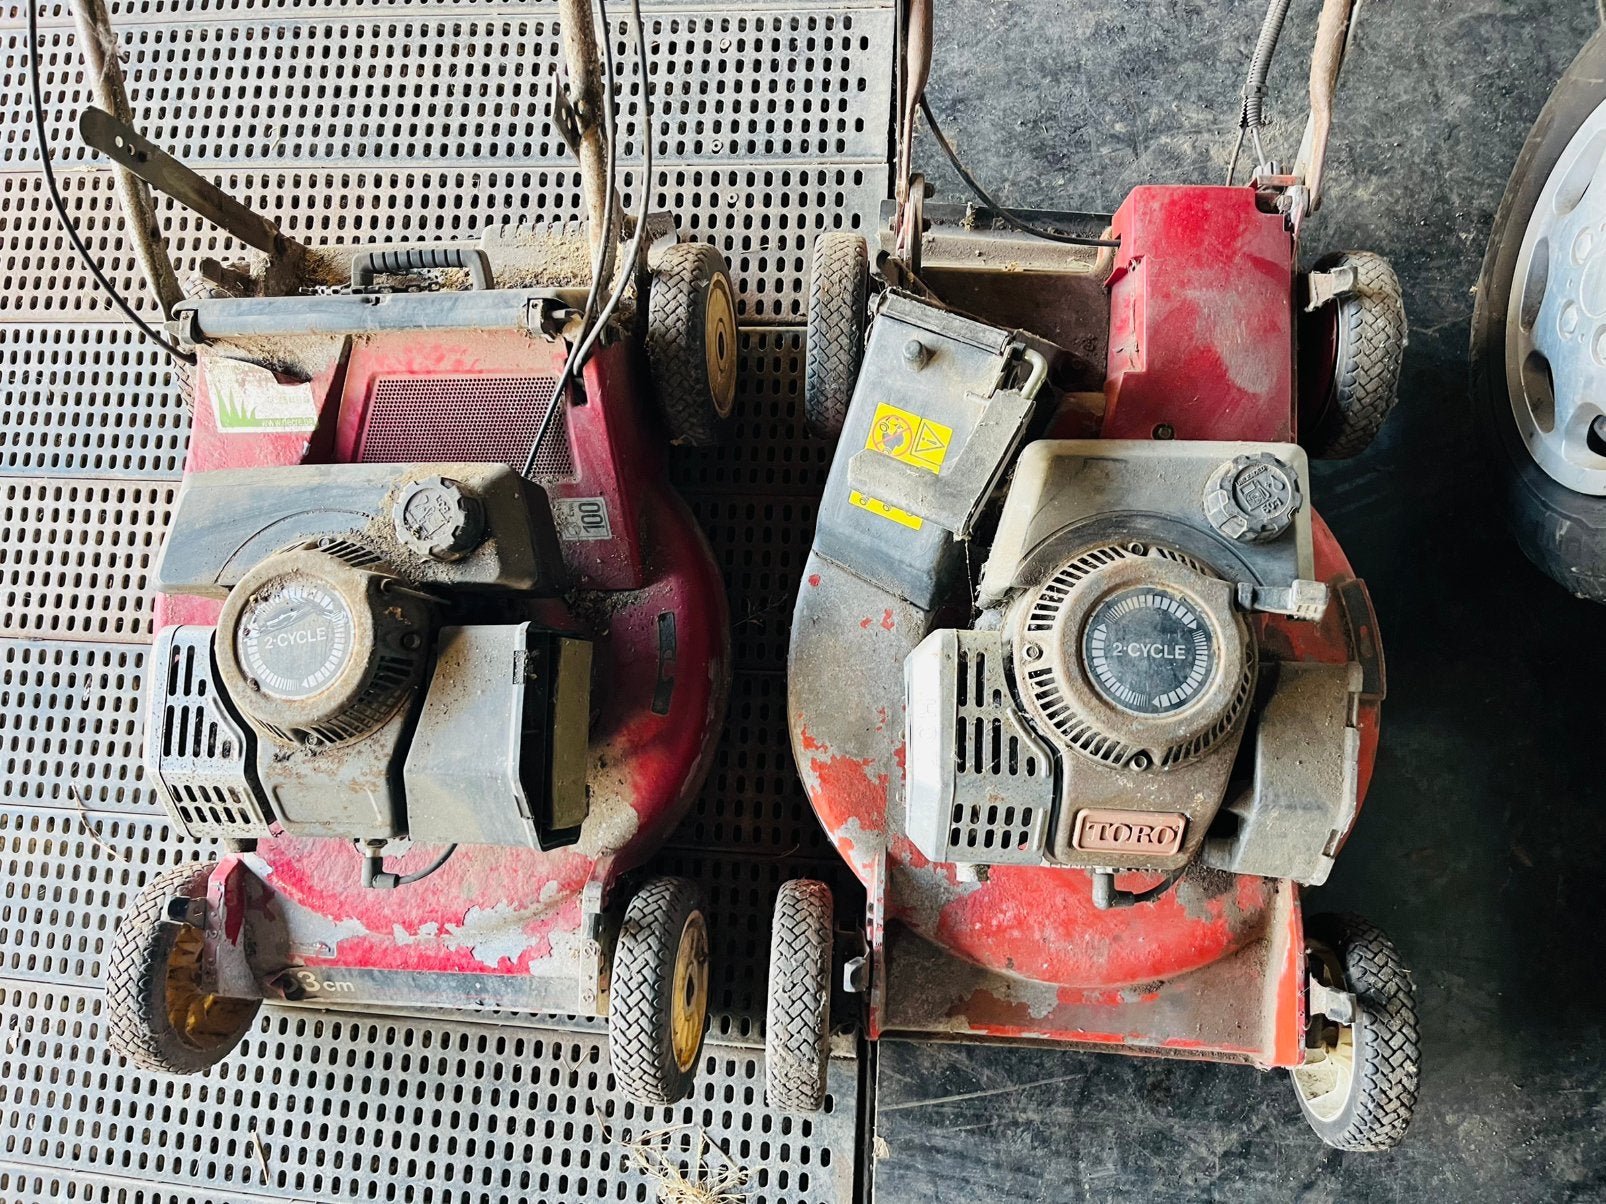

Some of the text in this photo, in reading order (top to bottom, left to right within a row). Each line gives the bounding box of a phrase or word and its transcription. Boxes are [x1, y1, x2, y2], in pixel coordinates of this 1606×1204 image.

[578, 502, 605, 534] 100
[1086, 821, 1175, 845] TORO
[323, 980, 356, 993] cm
